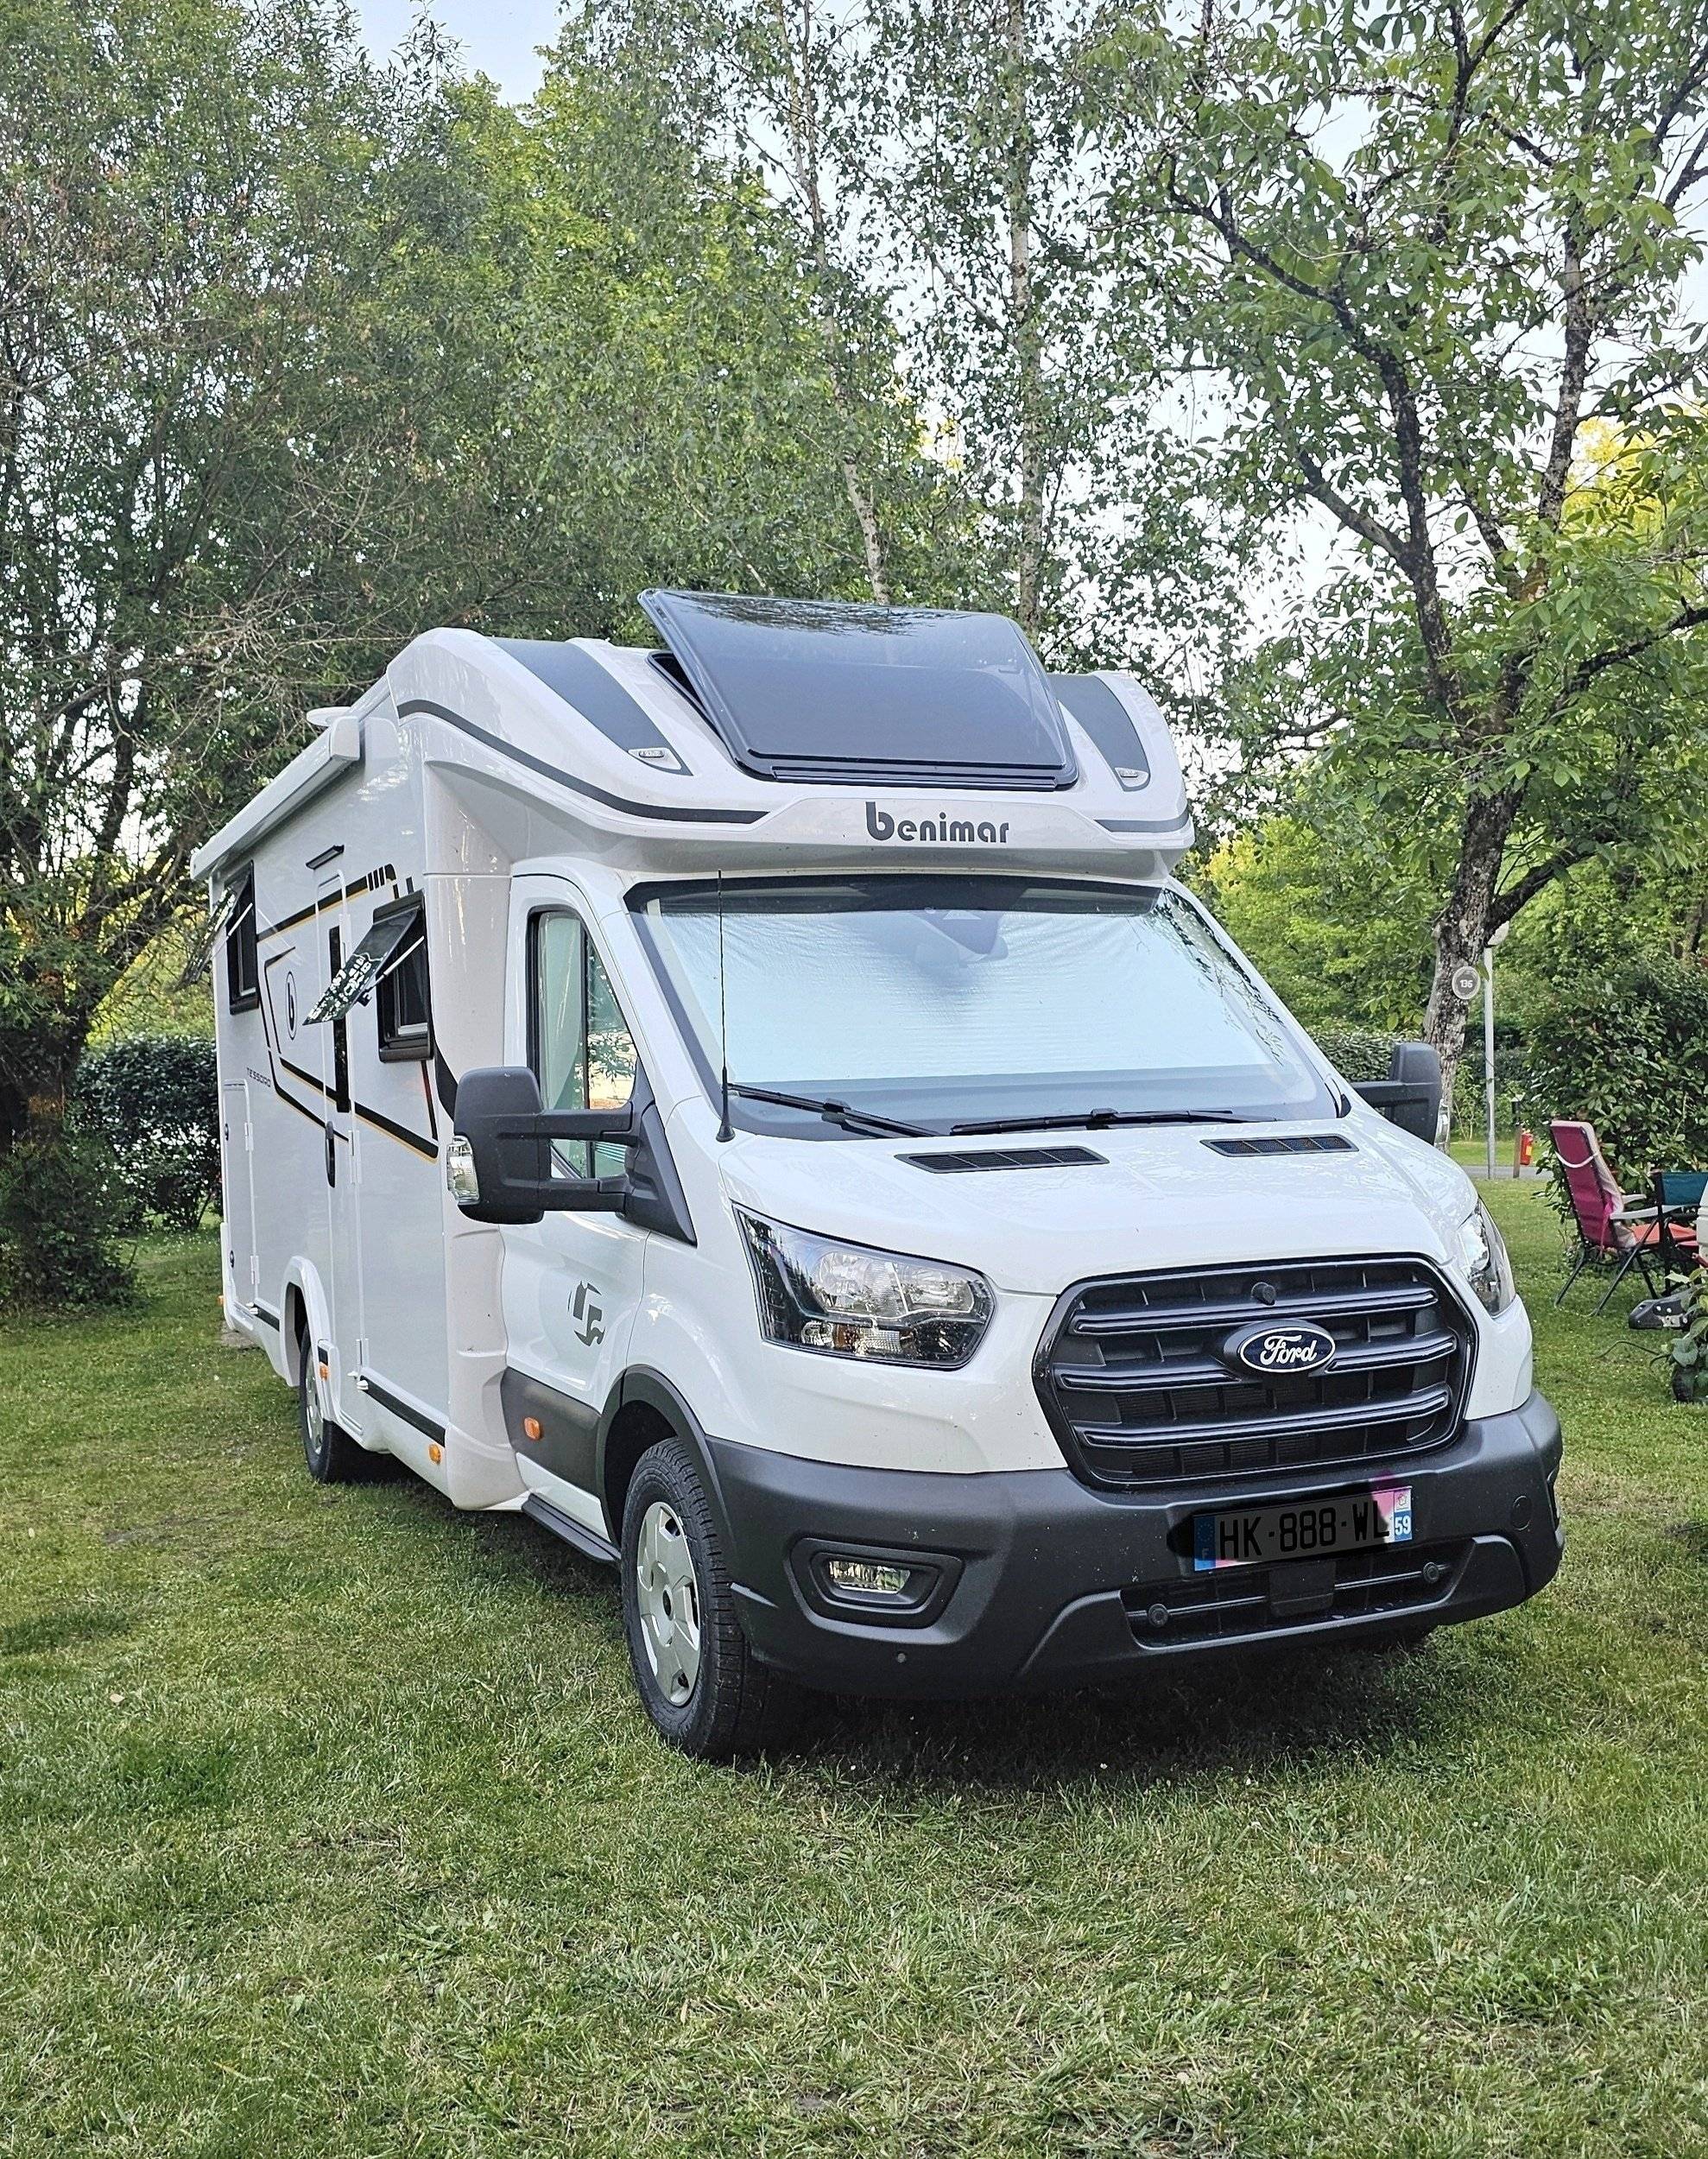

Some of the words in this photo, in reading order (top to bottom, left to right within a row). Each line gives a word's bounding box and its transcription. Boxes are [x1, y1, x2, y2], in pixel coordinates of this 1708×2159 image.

[865, 801, 1009, 843] benimar
[1260, 1334, 1318, 1365] Ford
[1395, 1515, 1412, 1536] 59
